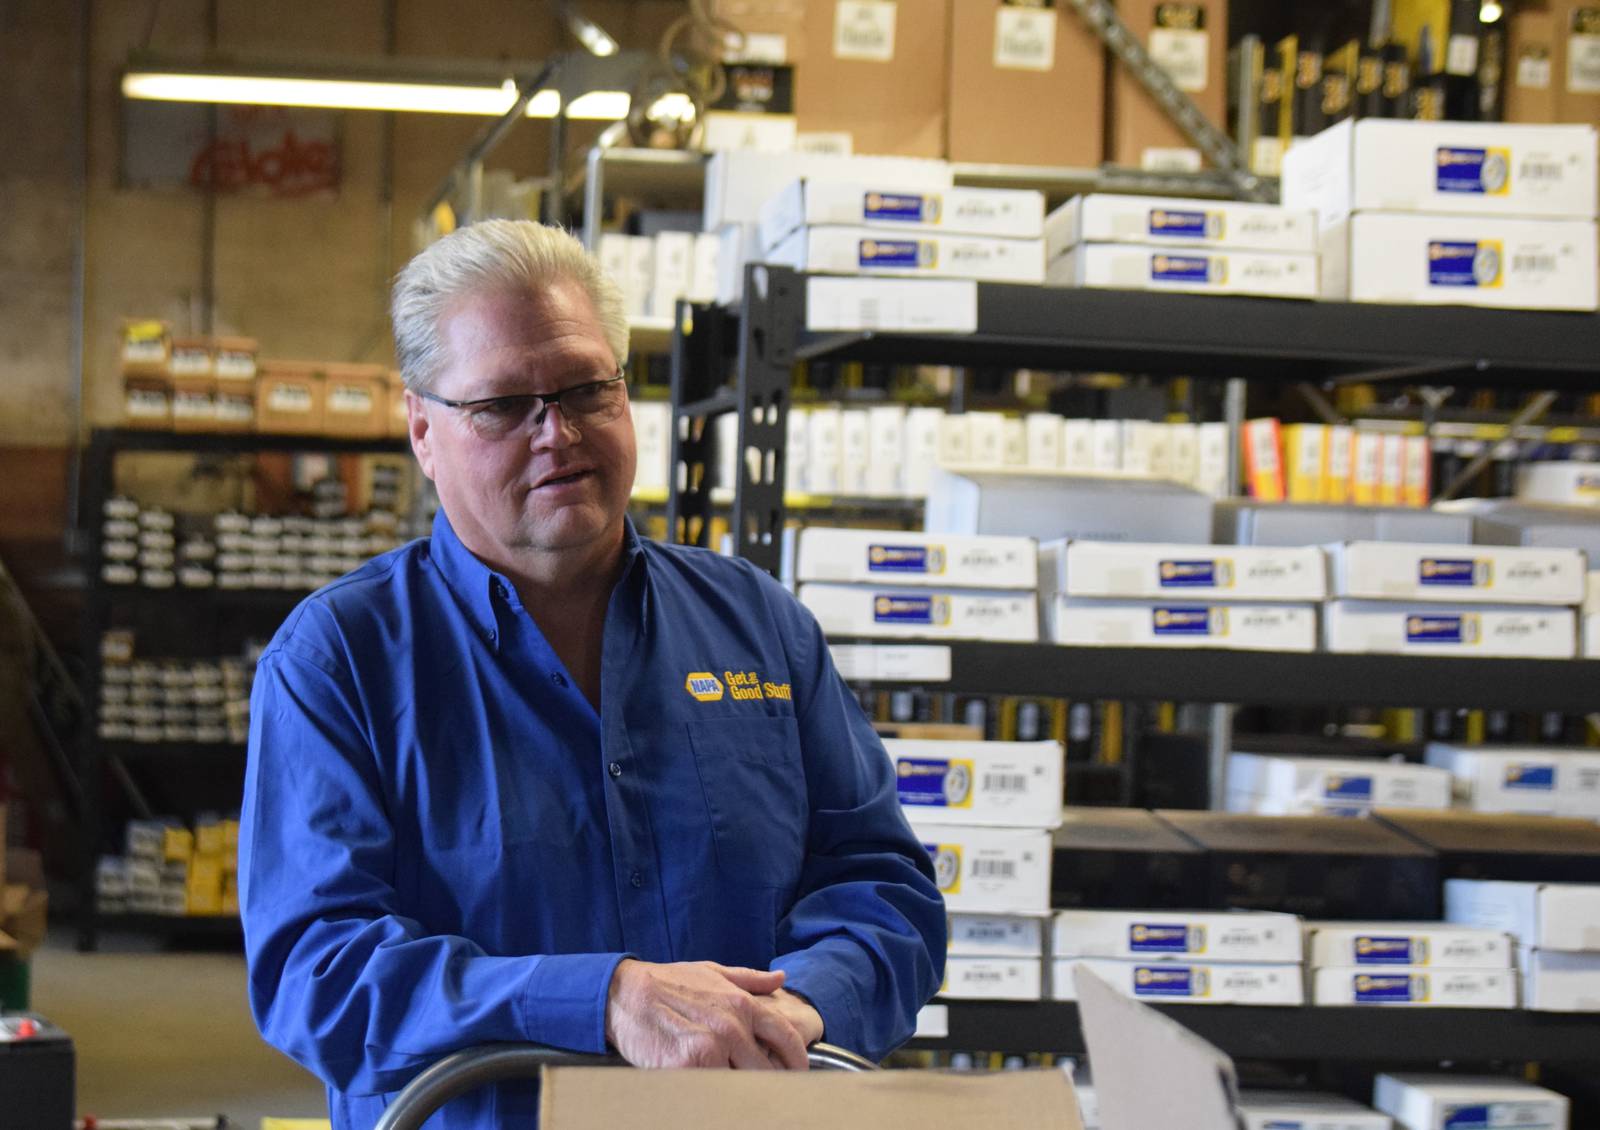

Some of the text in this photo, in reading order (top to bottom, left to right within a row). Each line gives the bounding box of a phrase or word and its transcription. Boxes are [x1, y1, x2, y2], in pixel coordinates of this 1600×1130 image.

[725, 671, 748, 685] Get
[691, 679, 720, 693] NAPA
[731, 682, 792, 701] Good Stuff
